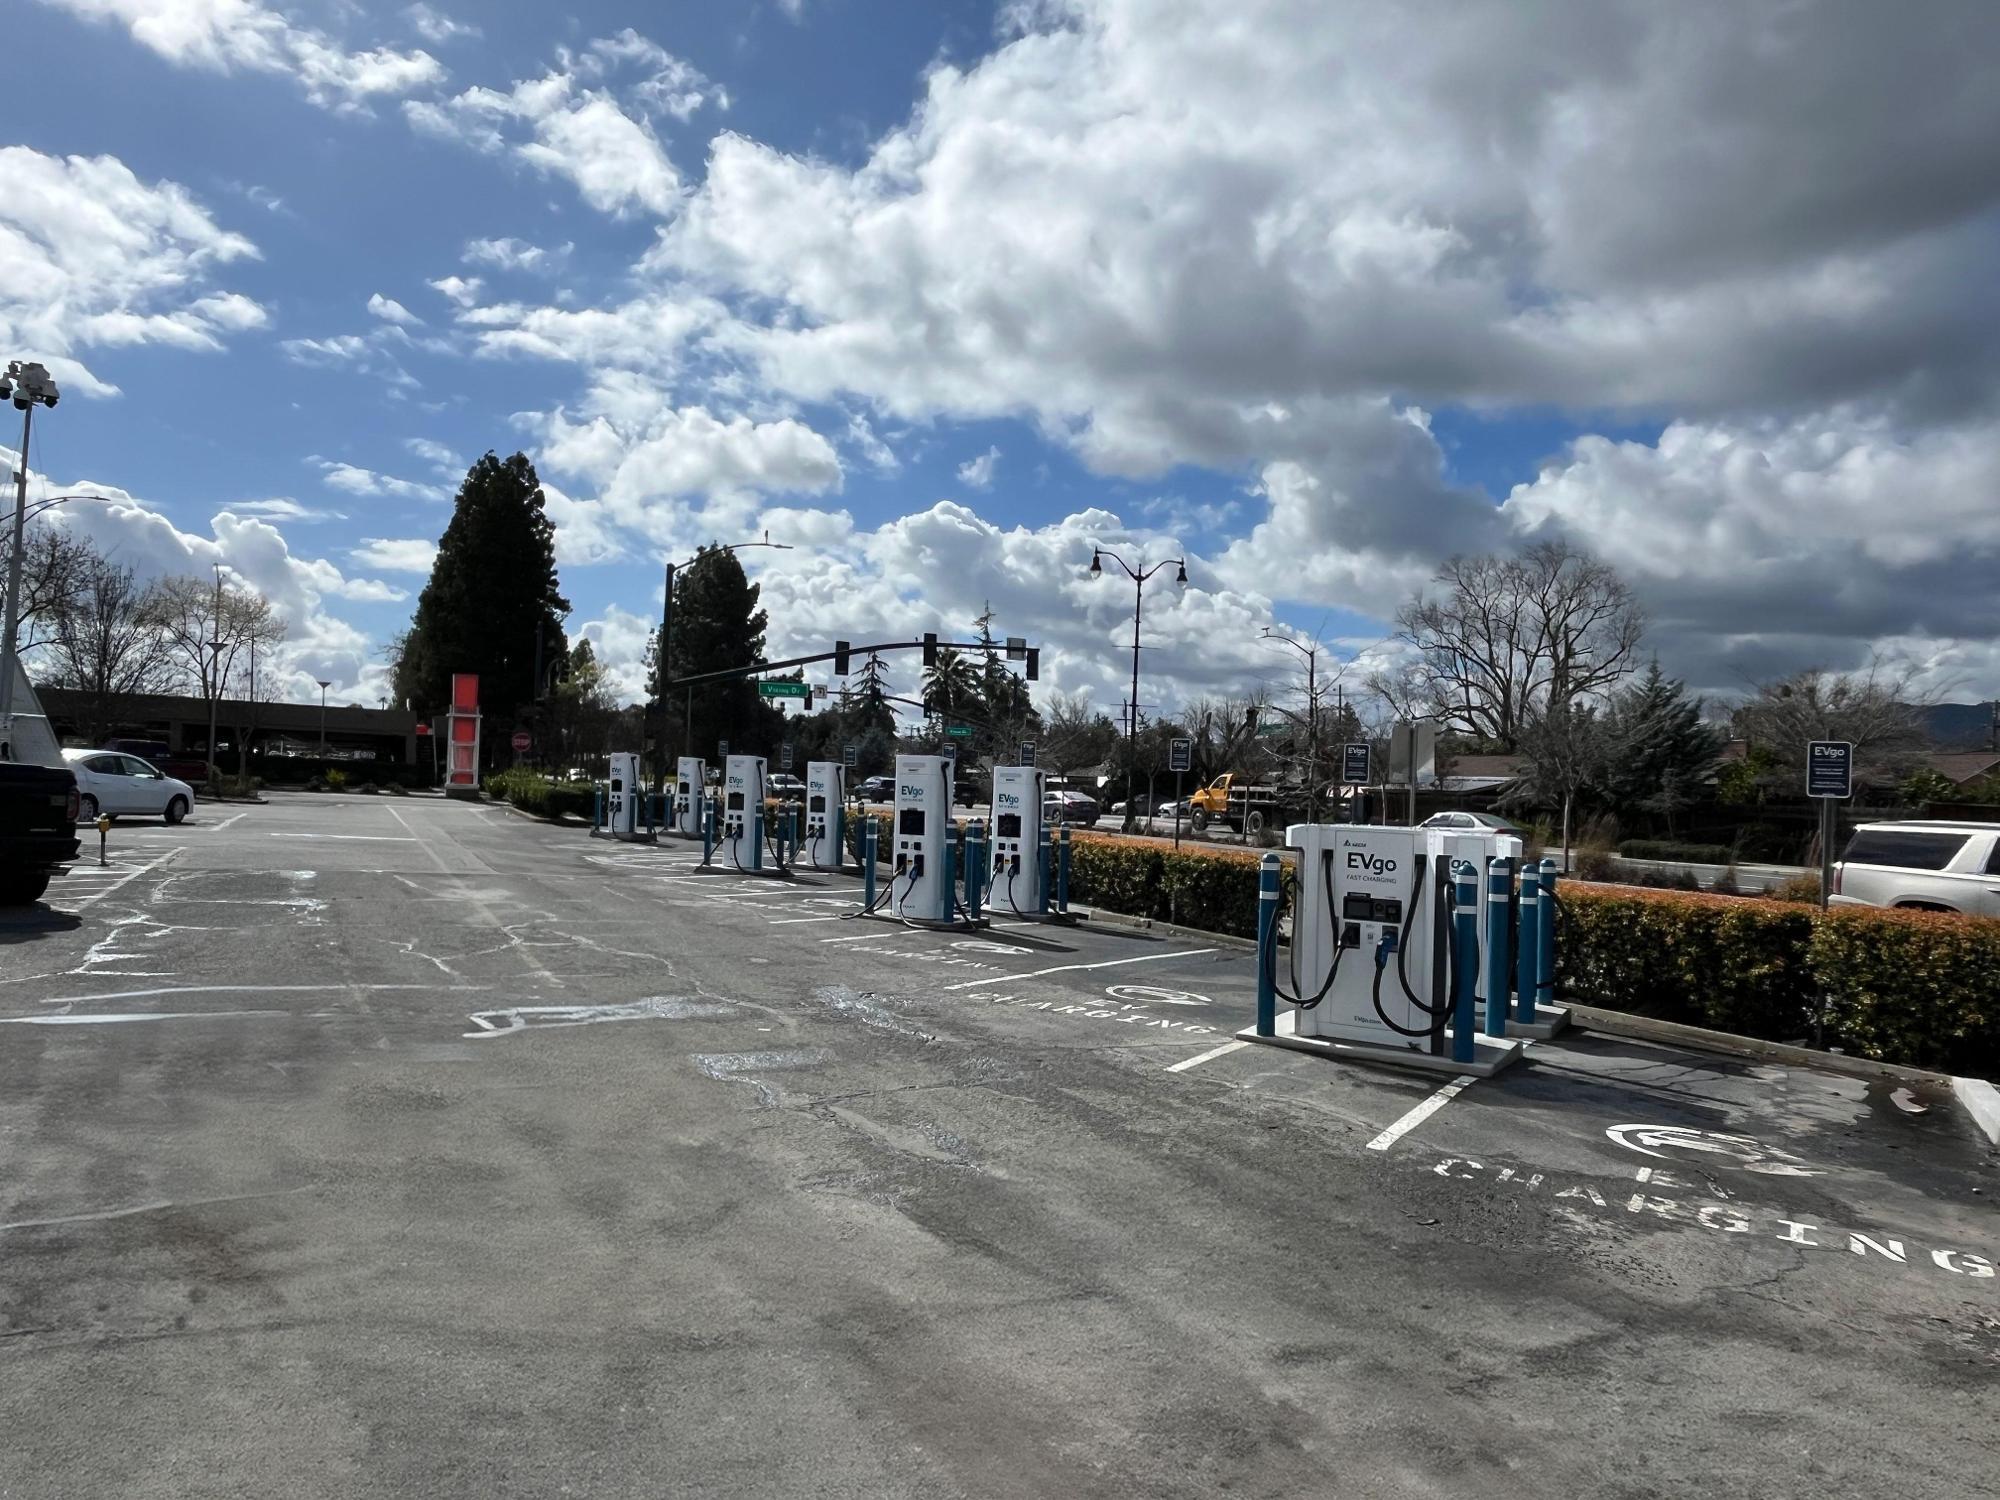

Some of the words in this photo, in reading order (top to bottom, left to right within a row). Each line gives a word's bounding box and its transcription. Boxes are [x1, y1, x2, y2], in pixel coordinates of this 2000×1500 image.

[1815, 746, 1845, 758] EVgo
[901, 785, 924, 799] EVgo
[998, 793, 1020, 806] EVgo
[1347, 852, 1397, 876] EVgo
[1433, 1157, 1996, 1278] CHARGING
